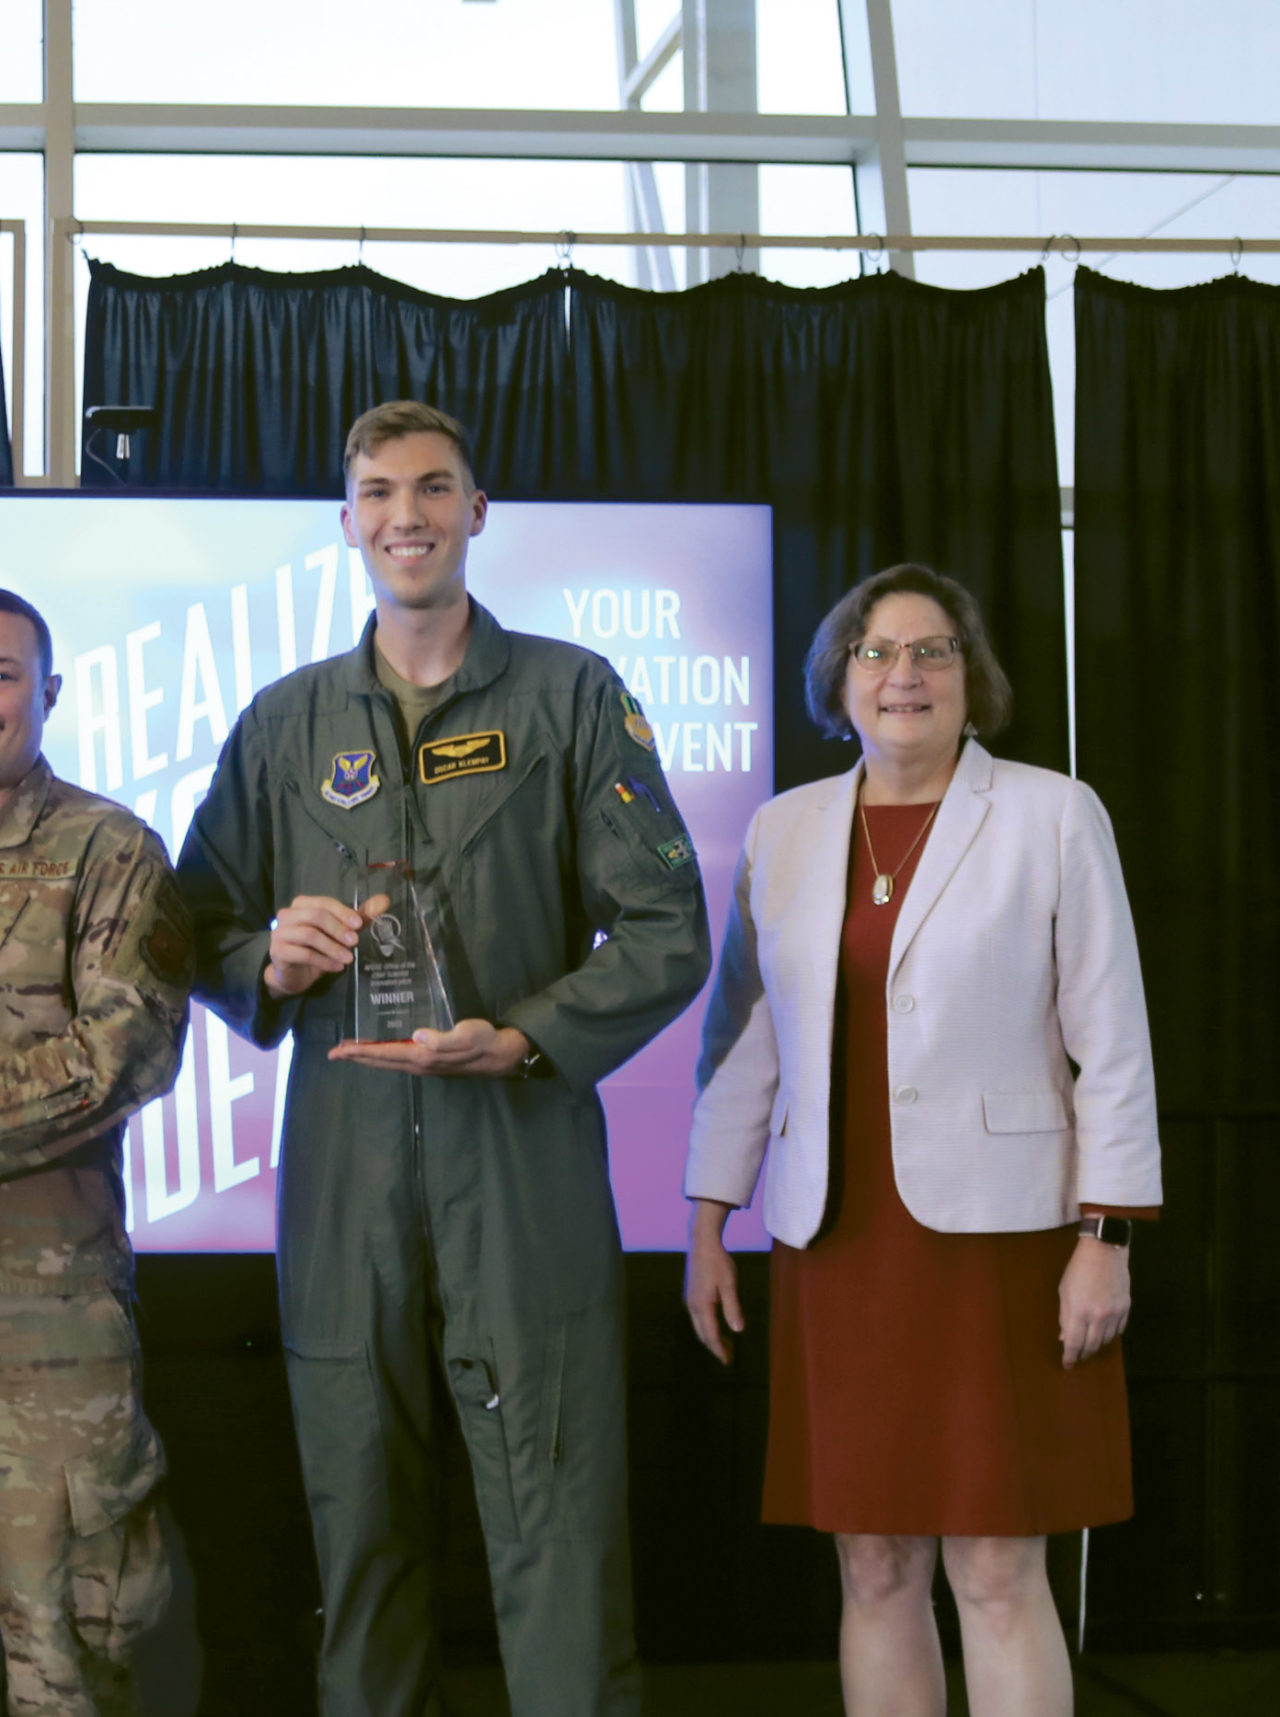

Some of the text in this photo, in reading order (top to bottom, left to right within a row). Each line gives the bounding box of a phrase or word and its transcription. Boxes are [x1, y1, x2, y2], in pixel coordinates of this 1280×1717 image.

[562, 587, 681, 639] YOUR
[9, 862, 29, 876] AIR
[32, 860, 71, 877] FORCE
[370, 991, 415, 1006] WINNER
